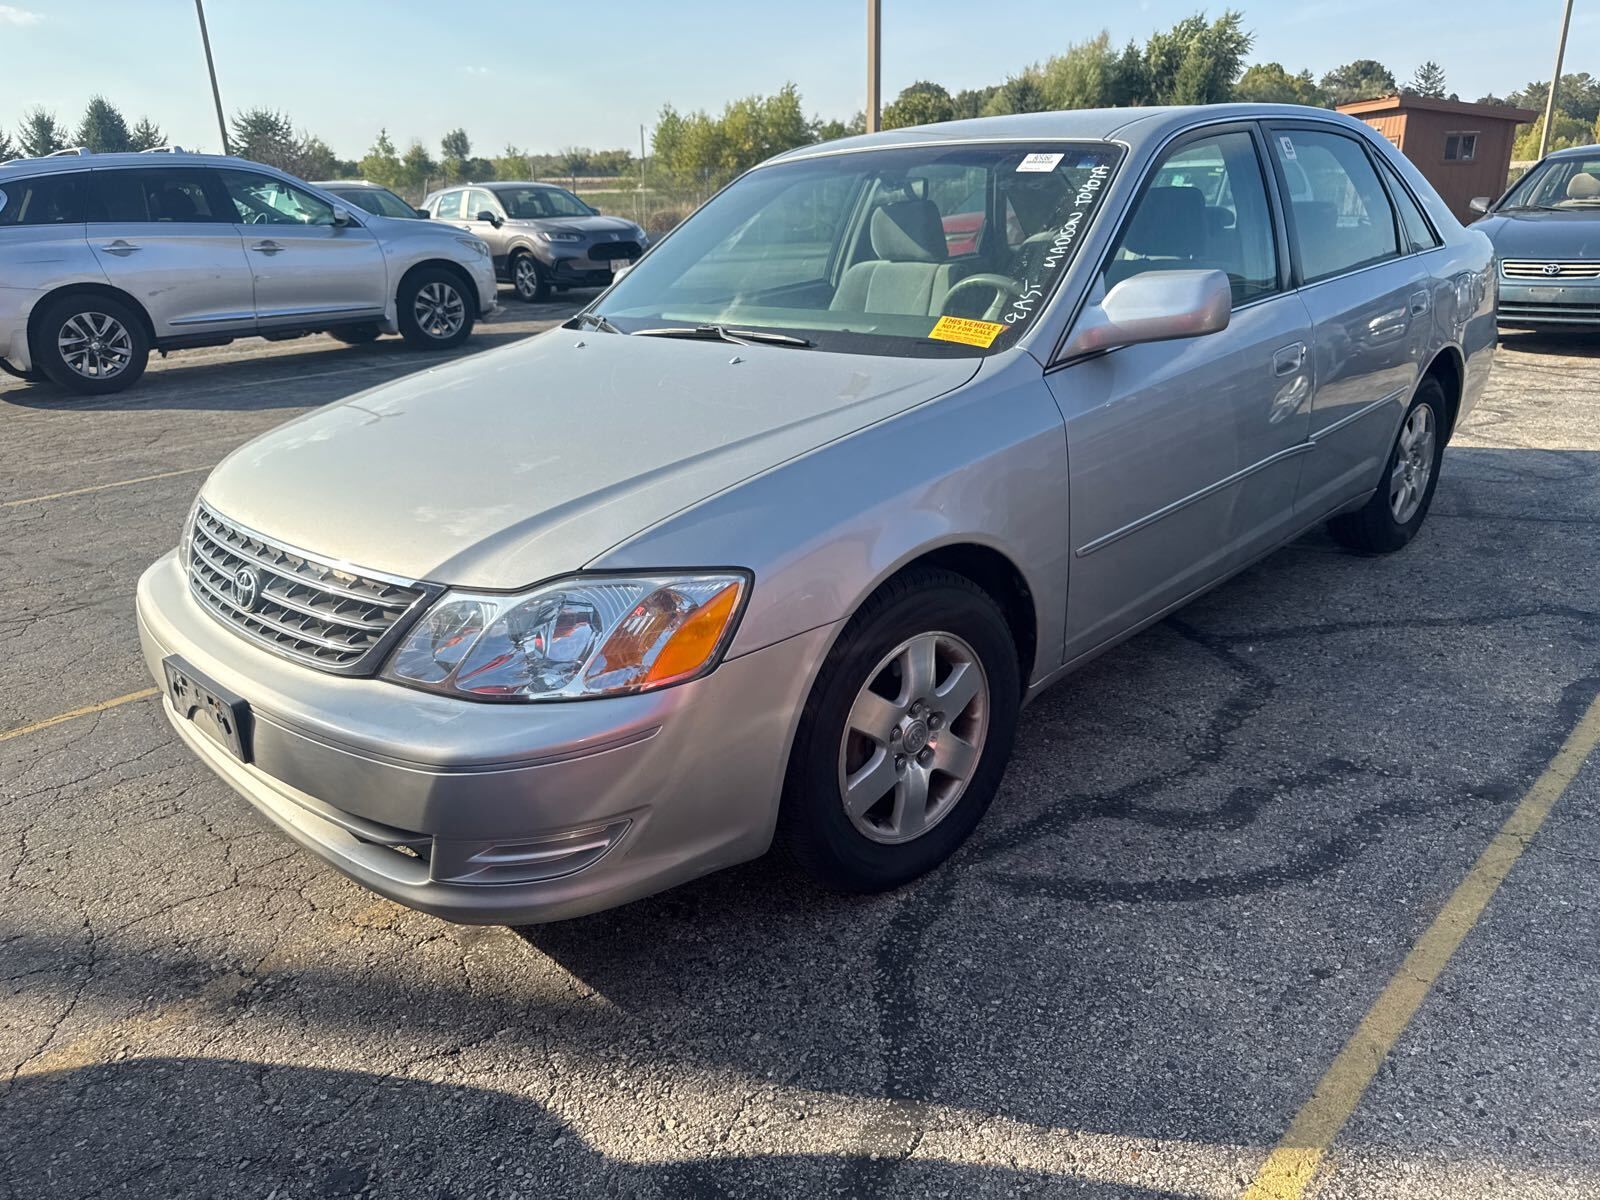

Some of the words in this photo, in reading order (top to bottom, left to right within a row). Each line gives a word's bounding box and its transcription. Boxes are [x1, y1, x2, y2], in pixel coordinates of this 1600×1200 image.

[1004, 279, 1042, 323] EAST
[1043, 212, 1083, 268] MADISON
[1074, 164, 1110, 207] TOYOTA
[944, 318, 961, 326] THIS
[964, 320, 998, 331] VEHICLE
[974, 328, 993, 336] SALE
